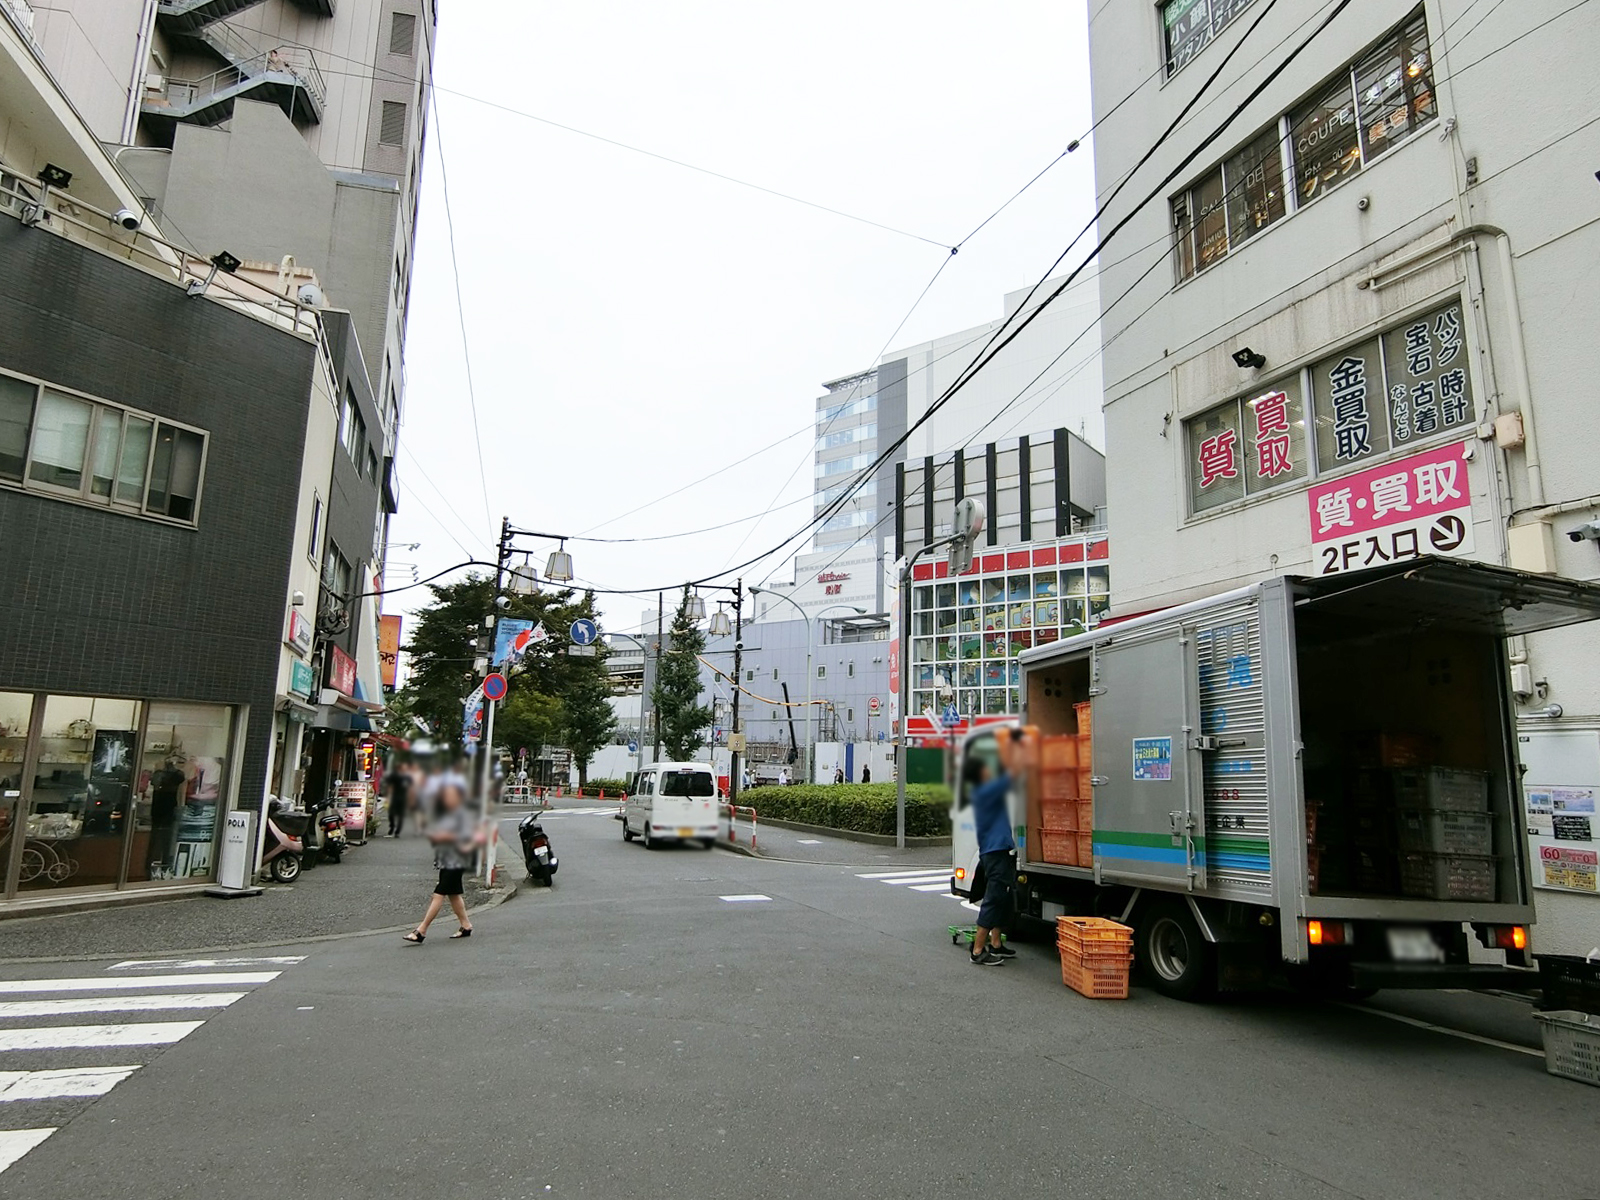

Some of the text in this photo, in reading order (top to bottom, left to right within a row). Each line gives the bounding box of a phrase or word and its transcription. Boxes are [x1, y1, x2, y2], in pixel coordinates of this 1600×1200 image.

[1298, 107, 1350, 153] COUPE
[1405, 322, 1438, 434] 宝石 古着
[1433, 307, 1468, 425] バッグ 時計
[1254, 390, 1293, 479] 買取
[1329, 356, 1371, 460] 金買取
[1390, 383, 1411, 440] なんでも
[1199, 428, 1237, 488] 質
[1315, 459, 1462, 535] 質・買取
[1321, 528, 1420, 575] 2F入口
[228, 819, 246, 828] POLA
